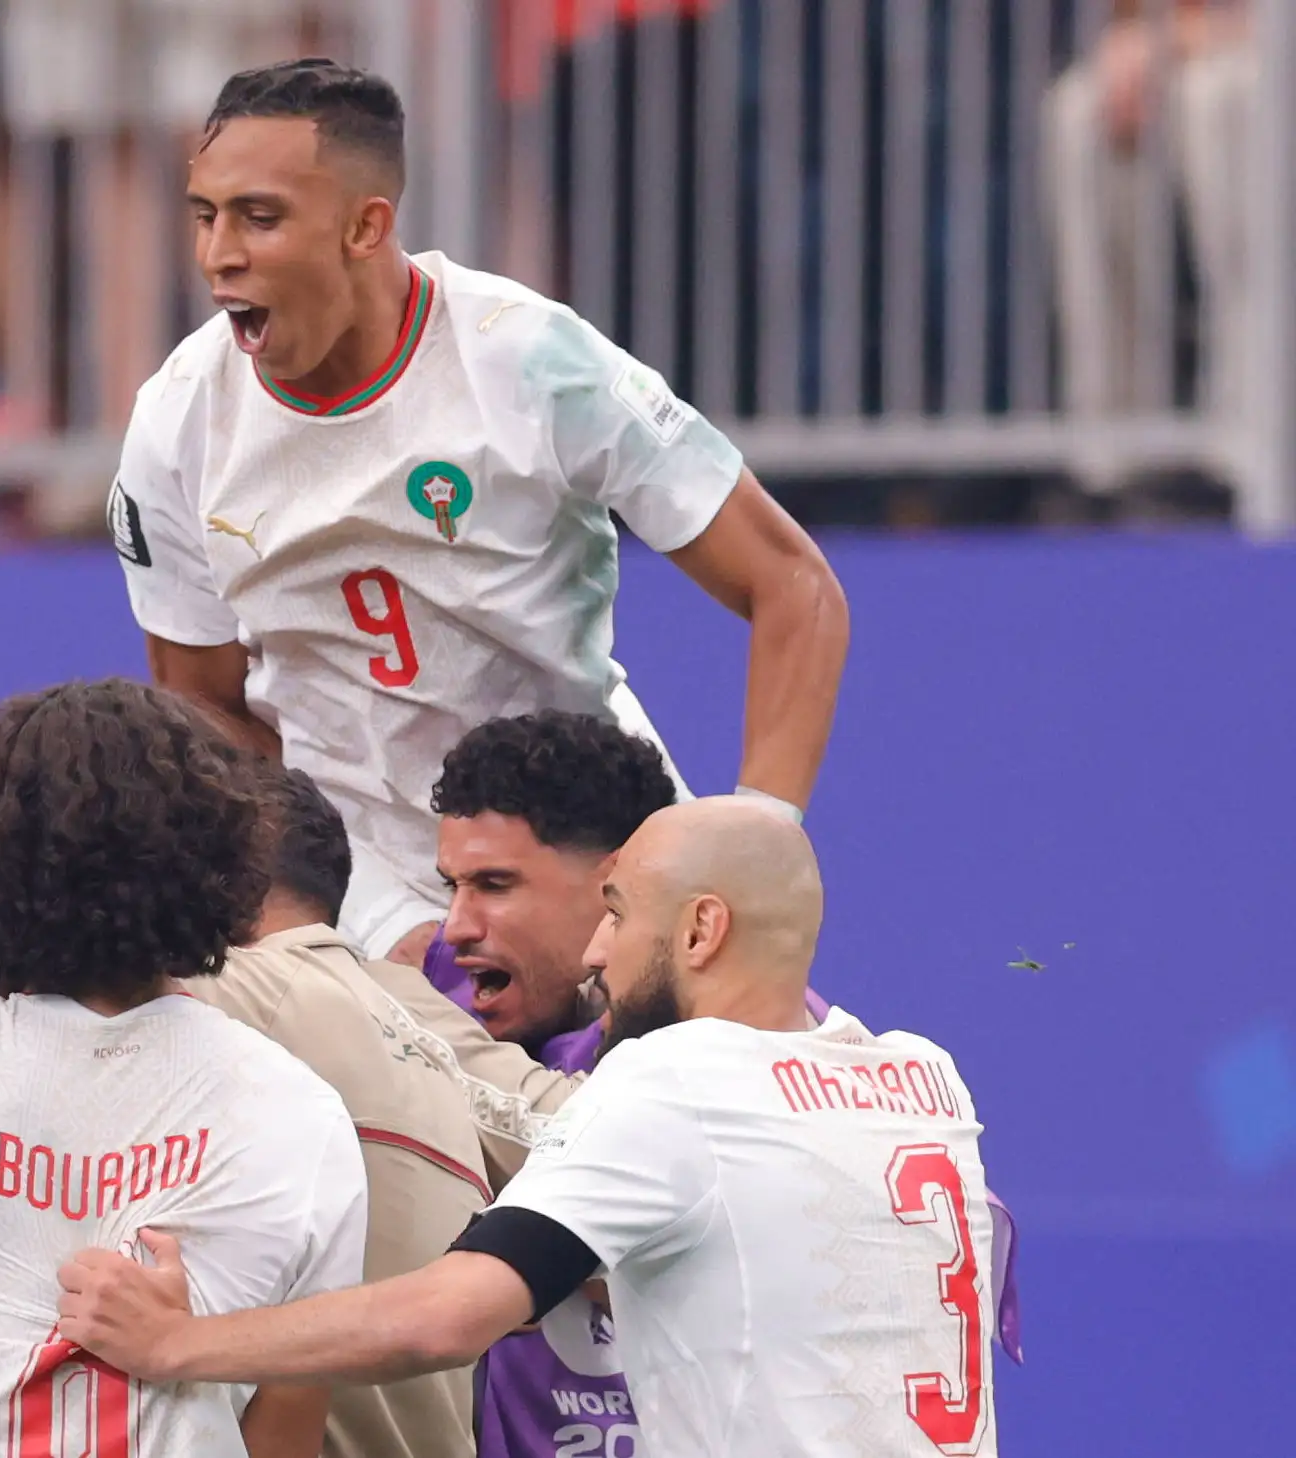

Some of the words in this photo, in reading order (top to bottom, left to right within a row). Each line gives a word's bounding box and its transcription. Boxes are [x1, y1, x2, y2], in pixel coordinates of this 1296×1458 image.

[340, 567, 420, 688] 9
[884, 1142, 988, 1458] 3
[551, 1389, 630, 1416] WOR
[553, 1423, 640, 1458] 20
